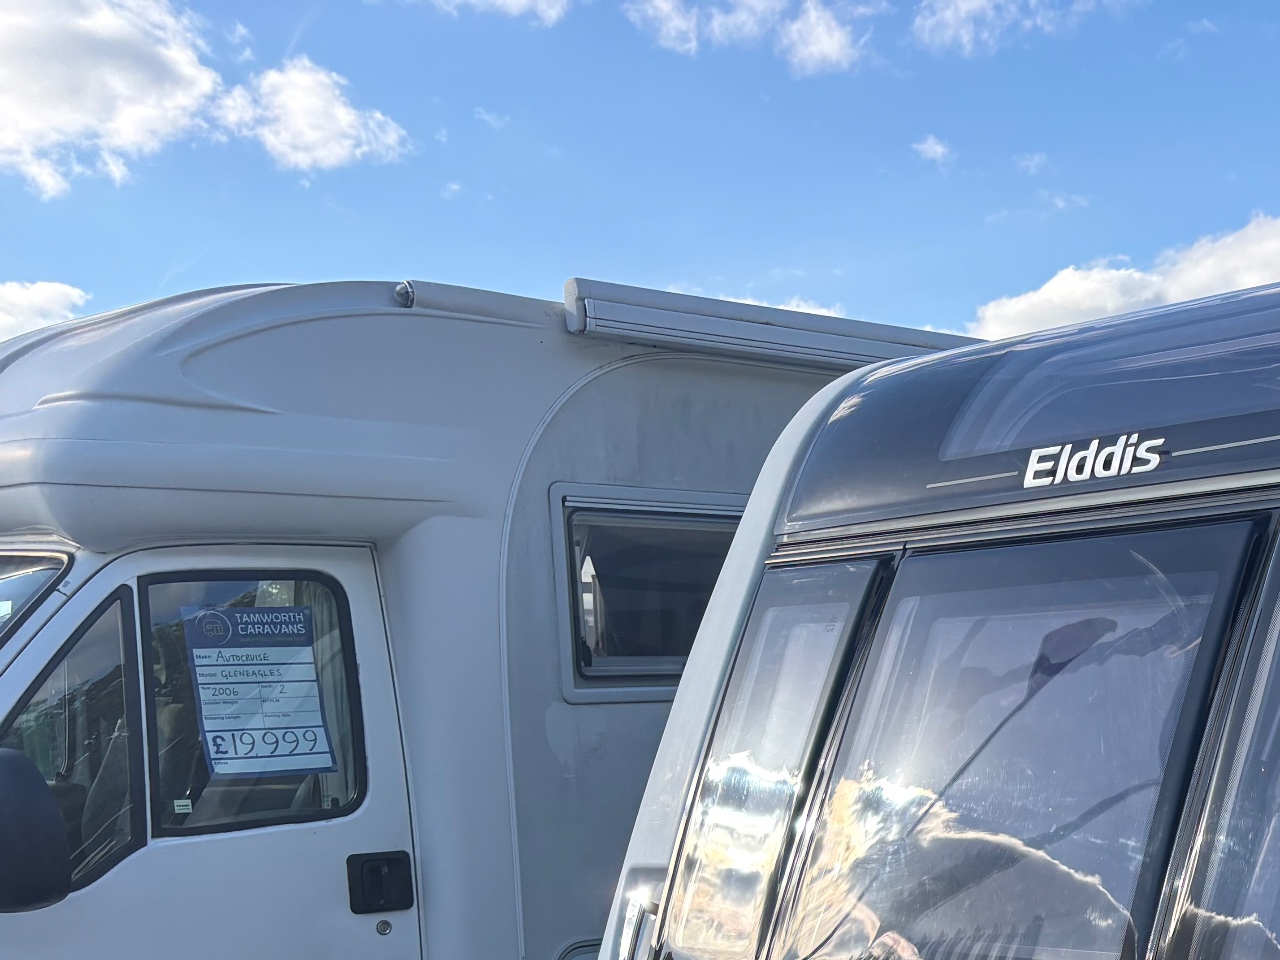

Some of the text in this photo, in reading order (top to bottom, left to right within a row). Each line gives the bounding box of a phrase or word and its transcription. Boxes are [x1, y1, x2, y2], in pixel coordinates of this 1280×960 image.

[1024, 433, 1165, 488] Elddis
[234, 612, 304, 623] TAMWORTH
[238, 623, 306, 635] CARAVANS
[216, 650, 270, 662] AUTOCRUISE
[221, 668, 282, 680] GLENEAGLES
[212, 687, 239, 697] 2006
[279, 684, 288, 694] 2
